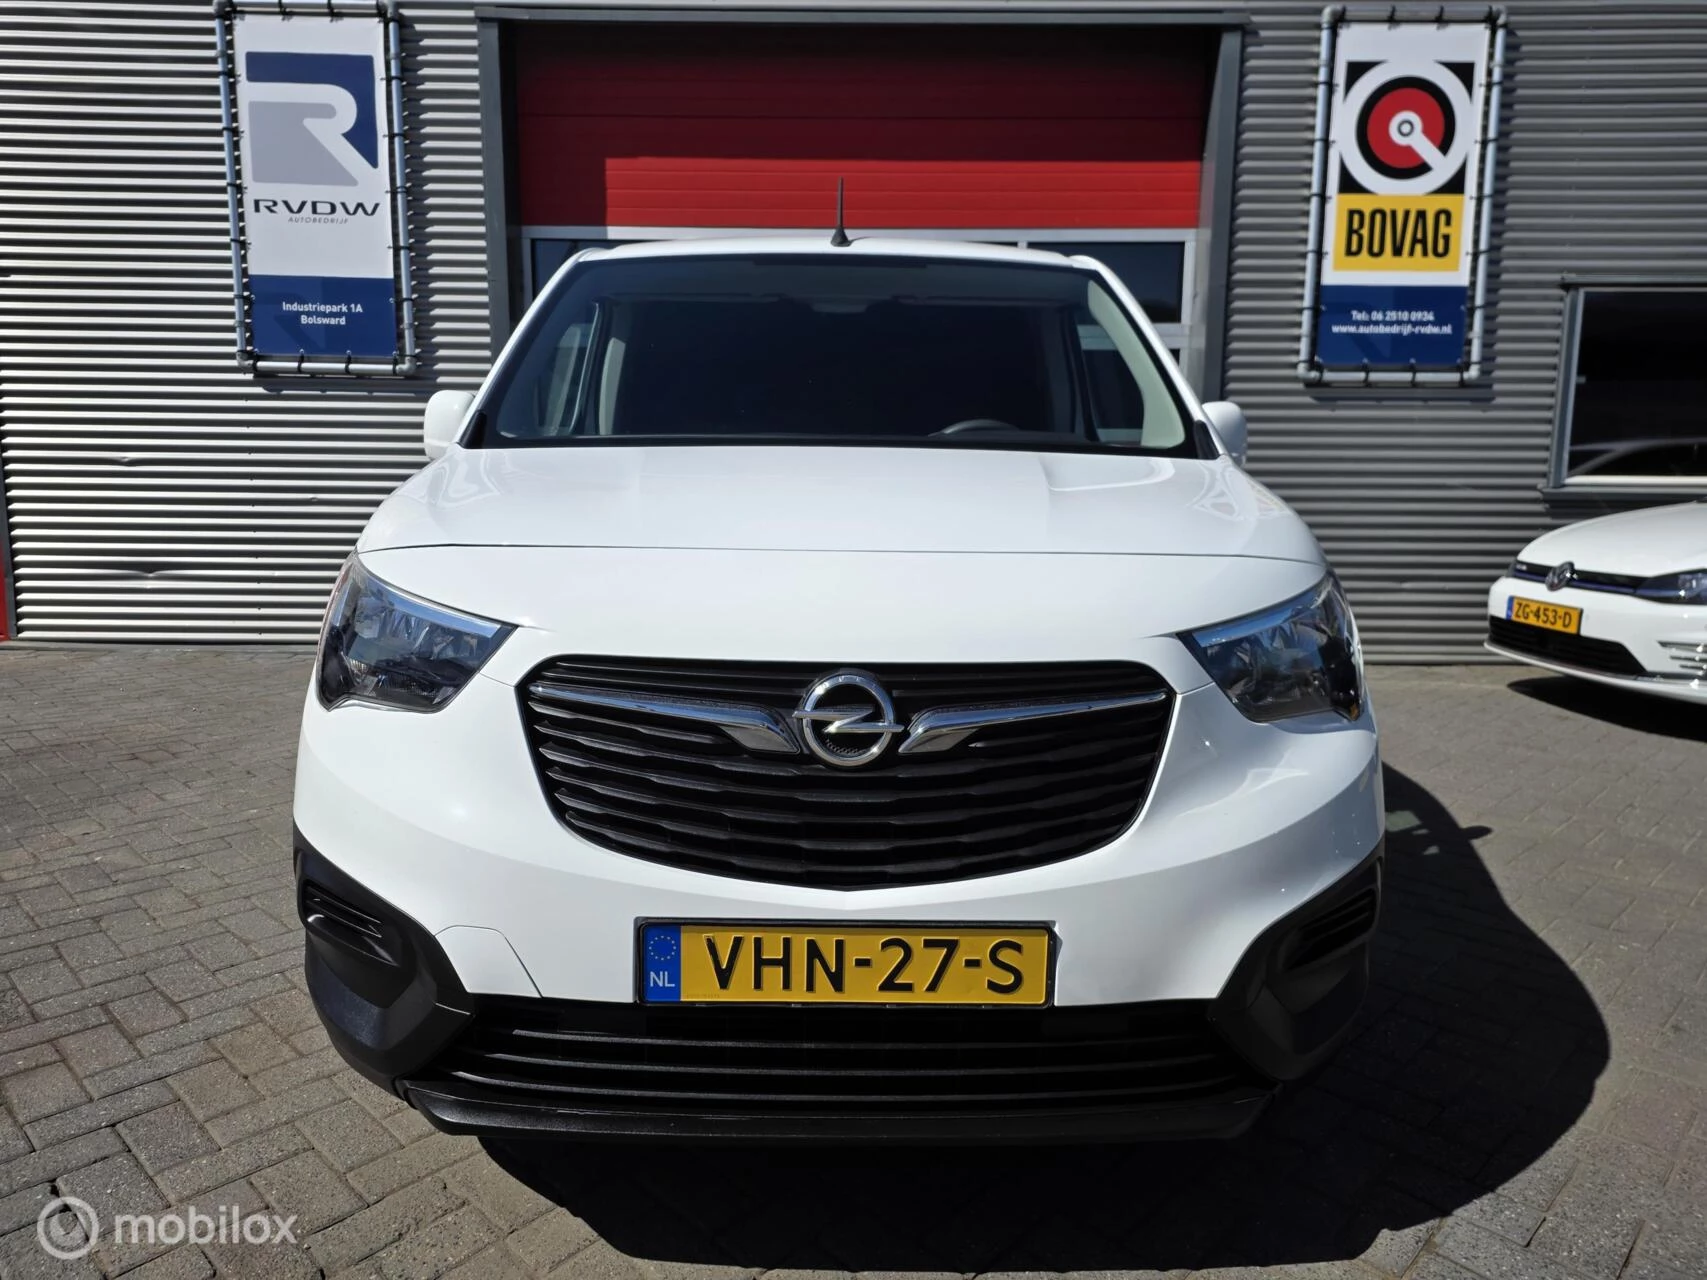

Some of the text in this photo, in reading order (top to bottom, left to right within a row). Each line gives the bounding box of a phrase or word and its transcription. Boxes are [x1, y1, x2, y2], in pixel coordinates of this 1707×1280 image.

[253, 198, 381, 217] RVDW
[287, 216, 349, 225] AUTOBEDRIJF
[1344, 208, 1453, 259] BOVAG
[282, 301, 364, 314] Industriepark 1A
[300, 315, 346, 326] Bolsward
[1371, 310, 1384, 321] 06
[1331, 323, 1453, 336] www.autobedrijf-rvdw.nl
[1514, 601, 1572, 628] ZG-453-D
[702, 934, 1024, 995] VHN-27-S
[649, 970, 676, 988] NL
